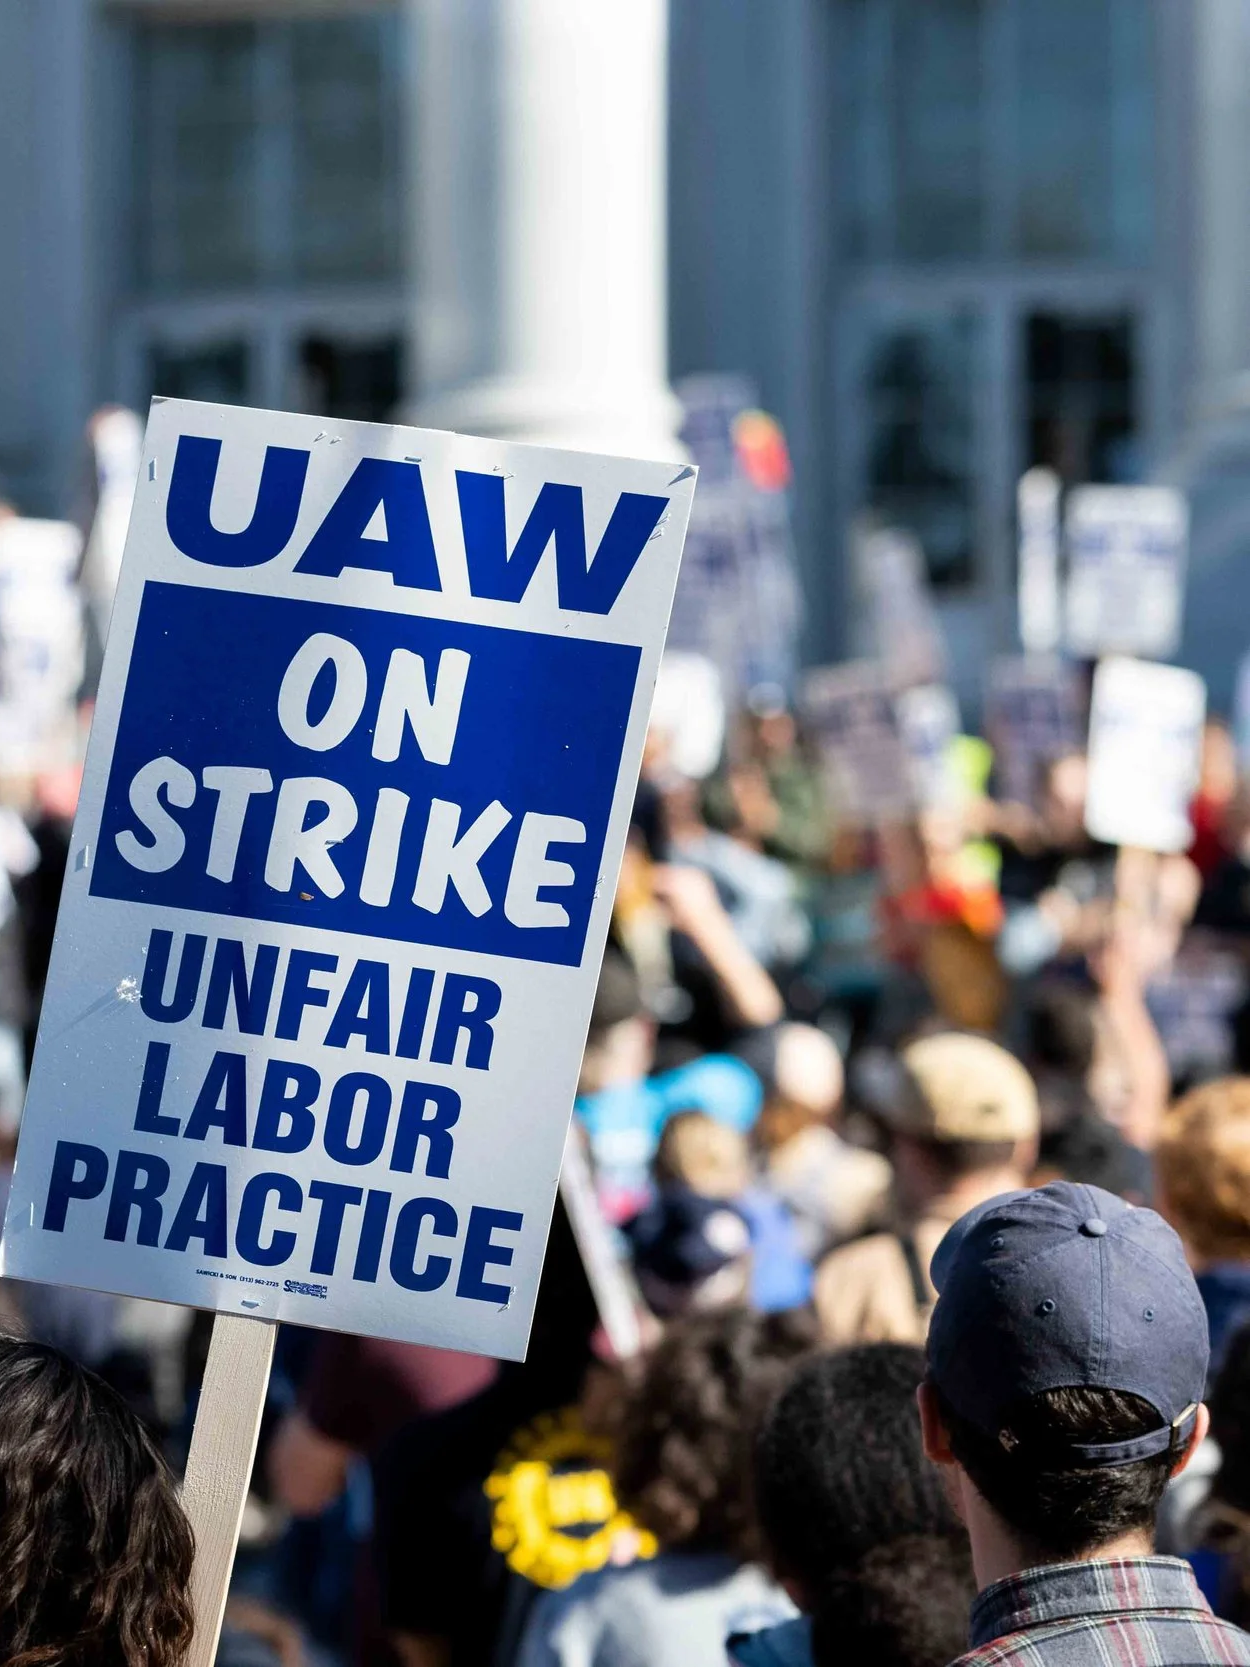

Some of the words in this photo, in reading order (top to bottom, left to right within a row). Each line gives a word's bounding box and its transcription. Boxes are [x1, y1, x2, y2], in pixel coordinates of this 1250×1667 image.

[166, 435, 669, 615] UAW
[278, 633, 471, 765] ON
[116, 756, 587, 929] STRIKE
[140, 929, 502, 1071] UNFAIR
[133, 1041, 462, 1179] LABOR
[42, 1140, 523, 1304] PRACTICE
[196, 1268, 219, 1278] SAWICKI
[225, 1273, 237, 1281] SON
